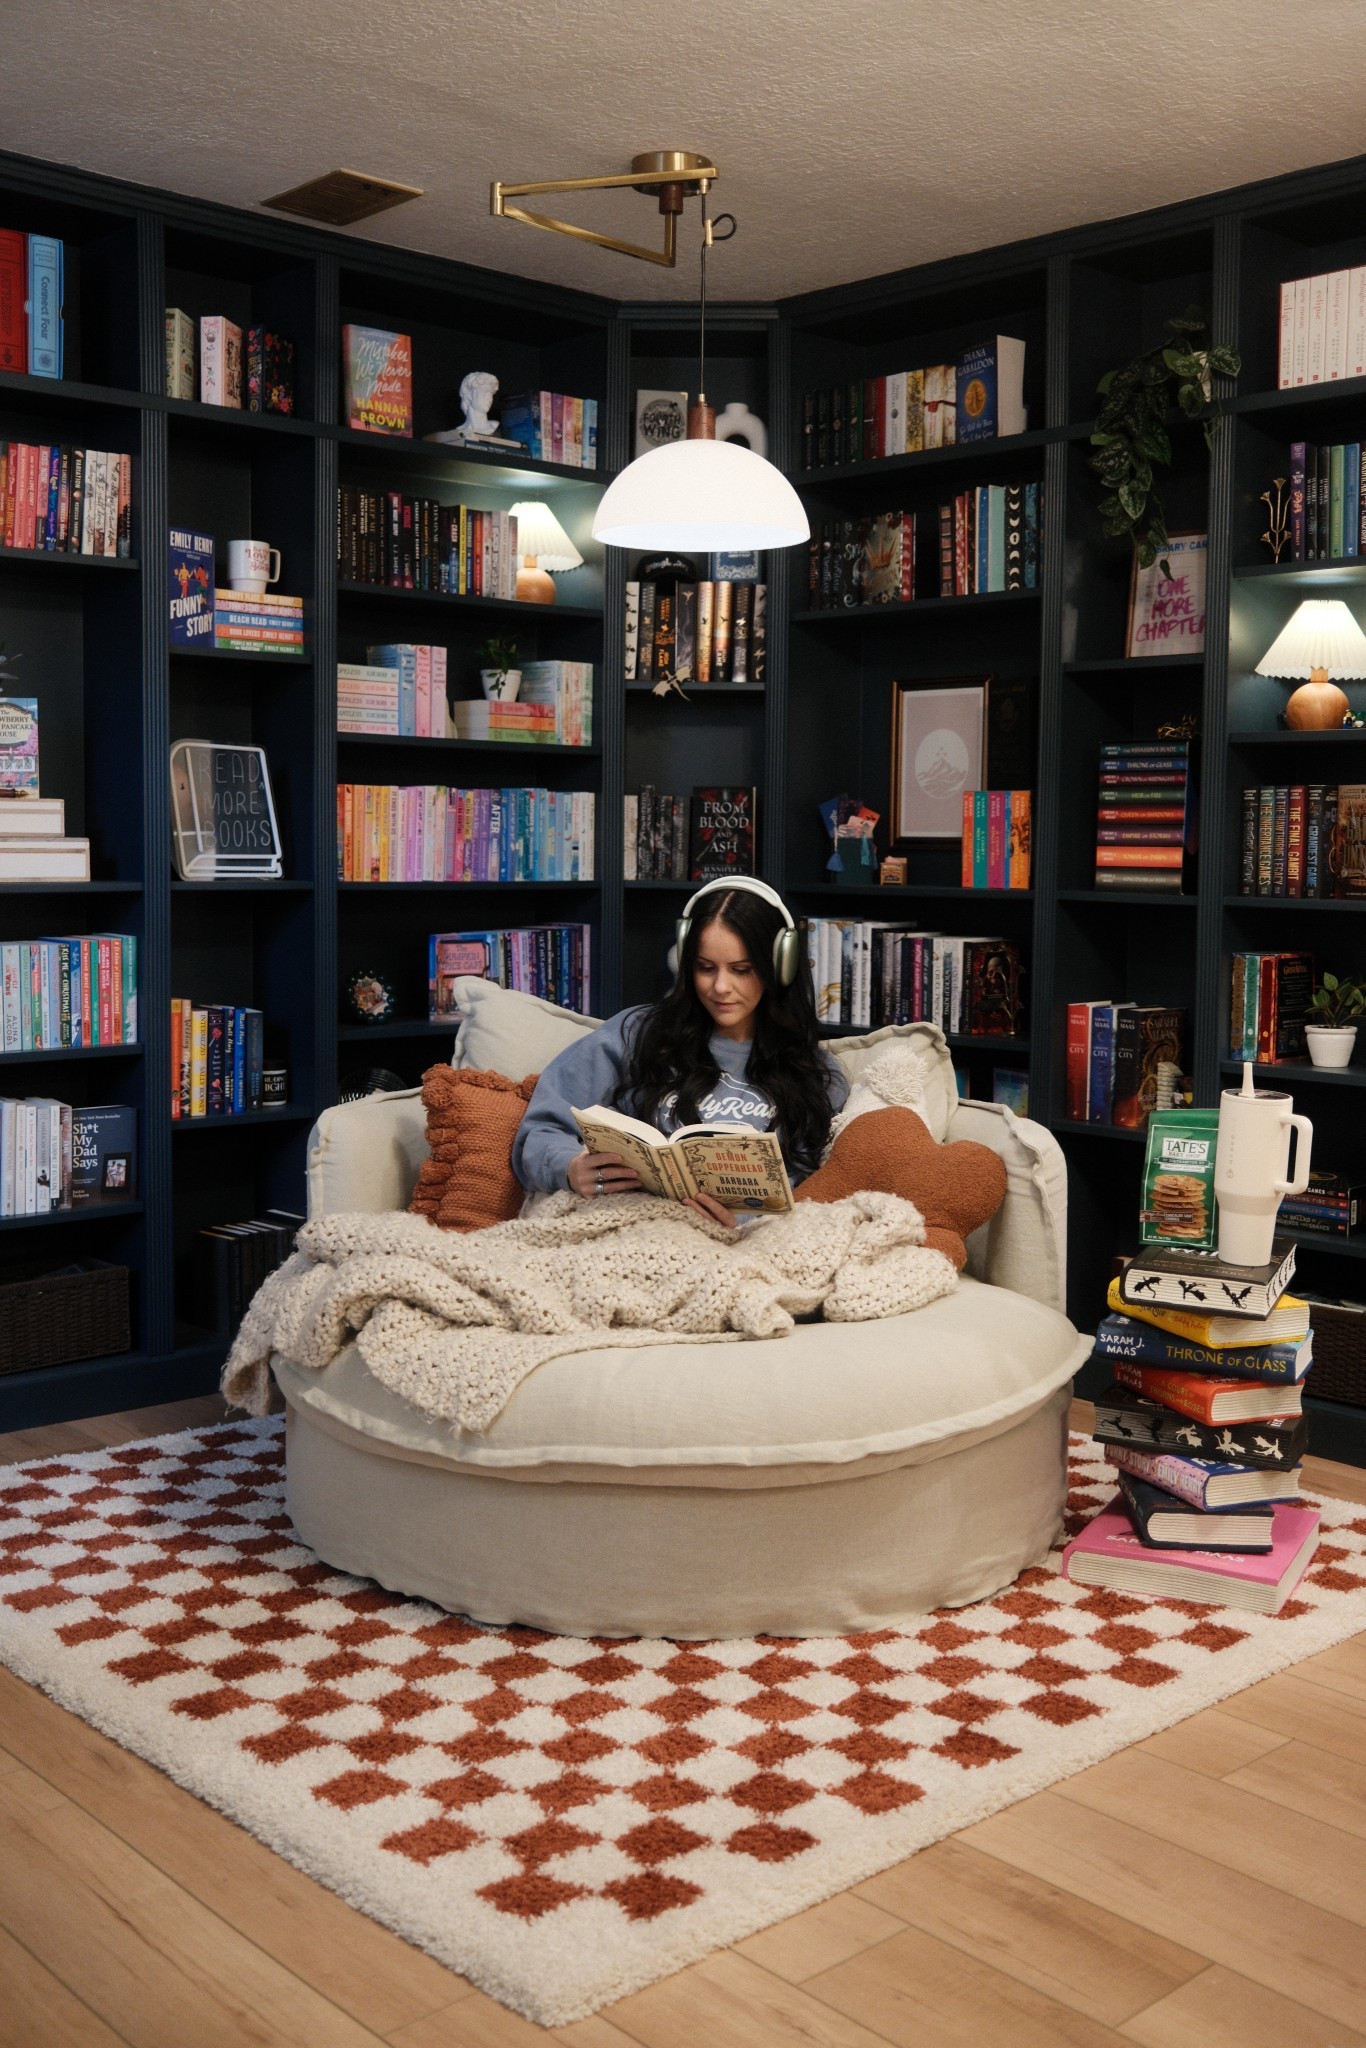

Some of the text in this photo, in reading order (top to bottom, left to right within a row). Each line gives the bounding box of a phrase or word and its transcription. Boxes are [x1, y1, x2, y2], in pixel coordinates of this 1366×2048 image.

[1333, 278, 1341, 308] breaking
[40, 276, 50, 340] Connect Four
[1282, 295, 1293, 327] twilight
[1312, 291, 1324, 320] eclipse
[357, 337, 409, 362] Mistakes
[964, 348, 986, 363] DIANA
[355, 358, 412, 380] We Never
[364, 377, 401, 397] Made
[356, 397, 408, 416] HANNAH
[360, 411, 405, 429] BROWN
[644, 423, 680, 438] WING
[74, 459, 82, 488] VARIATION
[403, 505, 412, 529] VICIOUS
[170, 530, 213, 555] EMILY HENRY
[1157, 575, 1191, 598] ONE
[170, 594, 203, 620] FUNNY
[1151, 595, 1196, 620] MORE
[186, 612, 213, 637] STORY
[229, 614, 250, 625] BEACH
[251, 616, 267, 626] READ
[199, 753, 260, 784] READ
[203, 790, 260, 815] MORE
[704, 801, 745, 814] FROM
[491, 804, 501, 833] AFTER
[699, 816, 750, 829] BLOOD
[203, 820, 271, 847] BOOKS
[1259, 802, 1272, 885] THE INHERITANCE GAMES
[1274, 816, 1285, 856] HAWTHORNE
[1287, 806, 1301, 881] THE FINAL GAMBIT
[709, 841, 737, 853] ASH
[1306, 825, 1319, 887] GRANDEST GAME
[1273, 858, 1284, 885] LEGACY
[62, 948, 70, 1013] KISS ME CHRISTMAS
[73, 1135, 93, 1147] My
[73, 1146, 97, 1157] Dad
[1166, 1140, 1206, 1154] TATE'S
[73, 1157, 98, 1170] Says
[707, 1162, 764, 1173] COPPERHEAD
[715, 1152, 748, 1162] DEMON
[716, 1186, 770, 1196] KINGSOLVER
[719, 1176, 759, 1186] BARBARA
[1307, 1187, 1326, 1195] GAMES
[1099, 1332, 1145, 1349] SARAH J.
[1106, 1344, 1137, 1356] MAAS
[1119, 1362, 1142, 1378] SARAH
[1165, 1345, 1287, 1373] THRONE OF GLASS
[1183, 1398, 1205, 1416] ROSES
[1128, 1453, 1151, 1474] STORY
[1157, 1462, 1179, 1485] EMILY
[1180, 1473, 1203, 1495] HENRY
